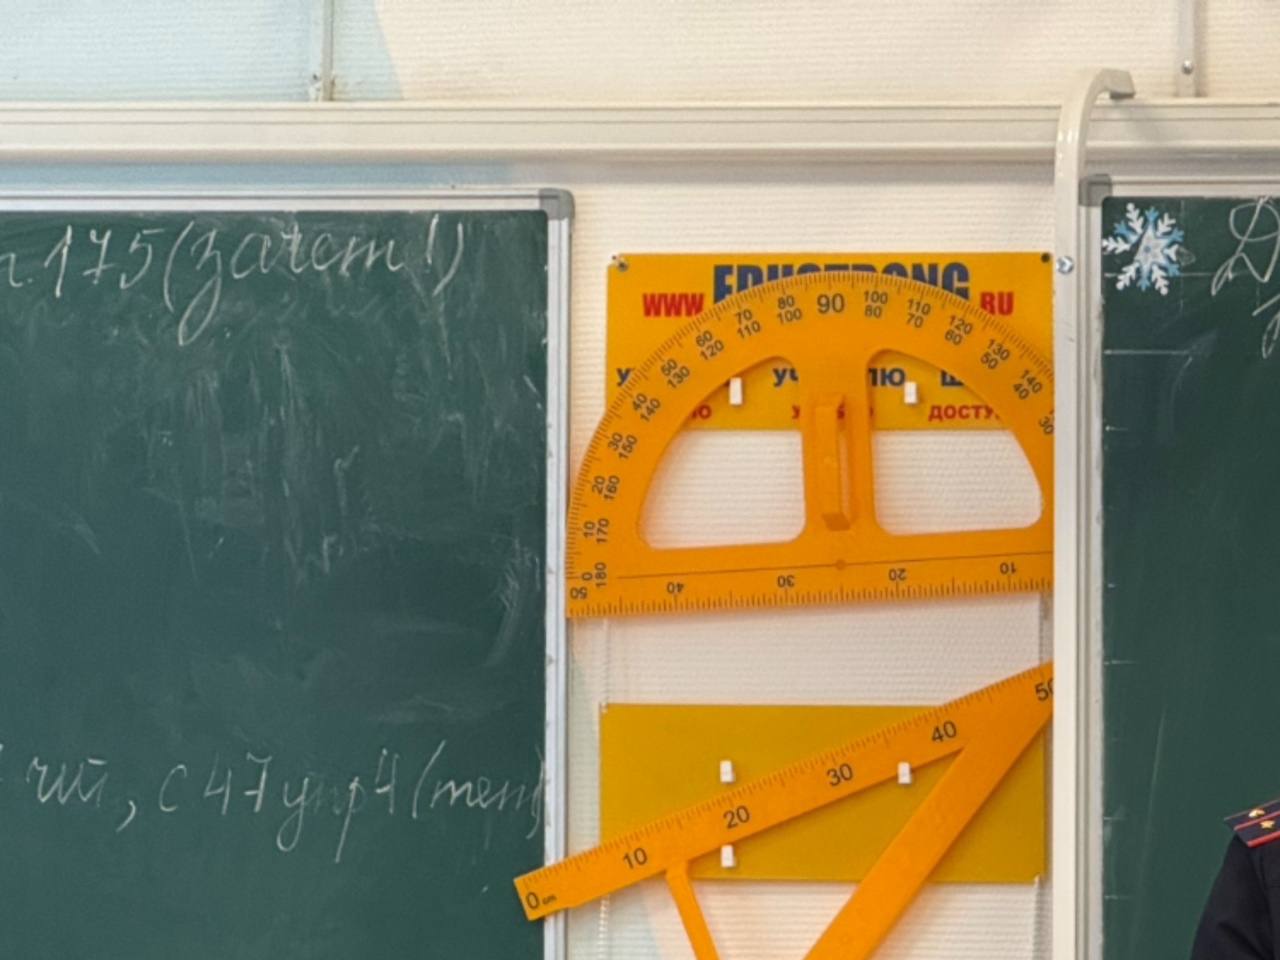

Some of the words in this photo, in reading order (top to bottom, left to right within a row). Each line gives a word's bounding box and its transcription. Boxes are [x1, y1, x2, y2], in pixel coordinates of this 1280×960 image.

[980, 292, 1015, 316] RU
[584, 521, 596, 538] 10
[592, 476, 606, 495] 20
[607, 432, 623, 451] 30
[632, 393, 648, 412] 40
[695, 330, 713, 348] 60
[736, 309, 753, 325] 70
[777, 295, 795, 310] 80
[816, 293, 845, 314] 90
[863, 291, 889, 306] 100
[907, 299, 931, 316] 110
[949, 315, 974, 336] 120
[987, 339, 1010, 361] 130
[1020, 370, 1043, 394] 140
[596, 518, 610, 544] 170
[639, 399, 661, 422] 140
[666, 366, 691, 390] 130
[700, 340, 725, 361] 120
[737, 321, 762, 340] 110
[777, 308, 803, 325] 100
[864, 306, 882, 319] 80
[906, 314, 924, 329] 70
[944, 330, 963, 346] 60
[980, 352, 999, 370] 50
[1013, 383, 1030, 400] 40
[888, 568, 906, 581] 20
[1000, 562, 1017, 575] 10
[777, 575, 795, 588] 30
[570, 587, 588, 600] 50
[667, 582, 685, 595] 40
[622, 847, 648, 870] 10
[722, 805, 751, 830] 20
[826, 763, 854, 787] 30
[930, 720, 958, 744] 40
